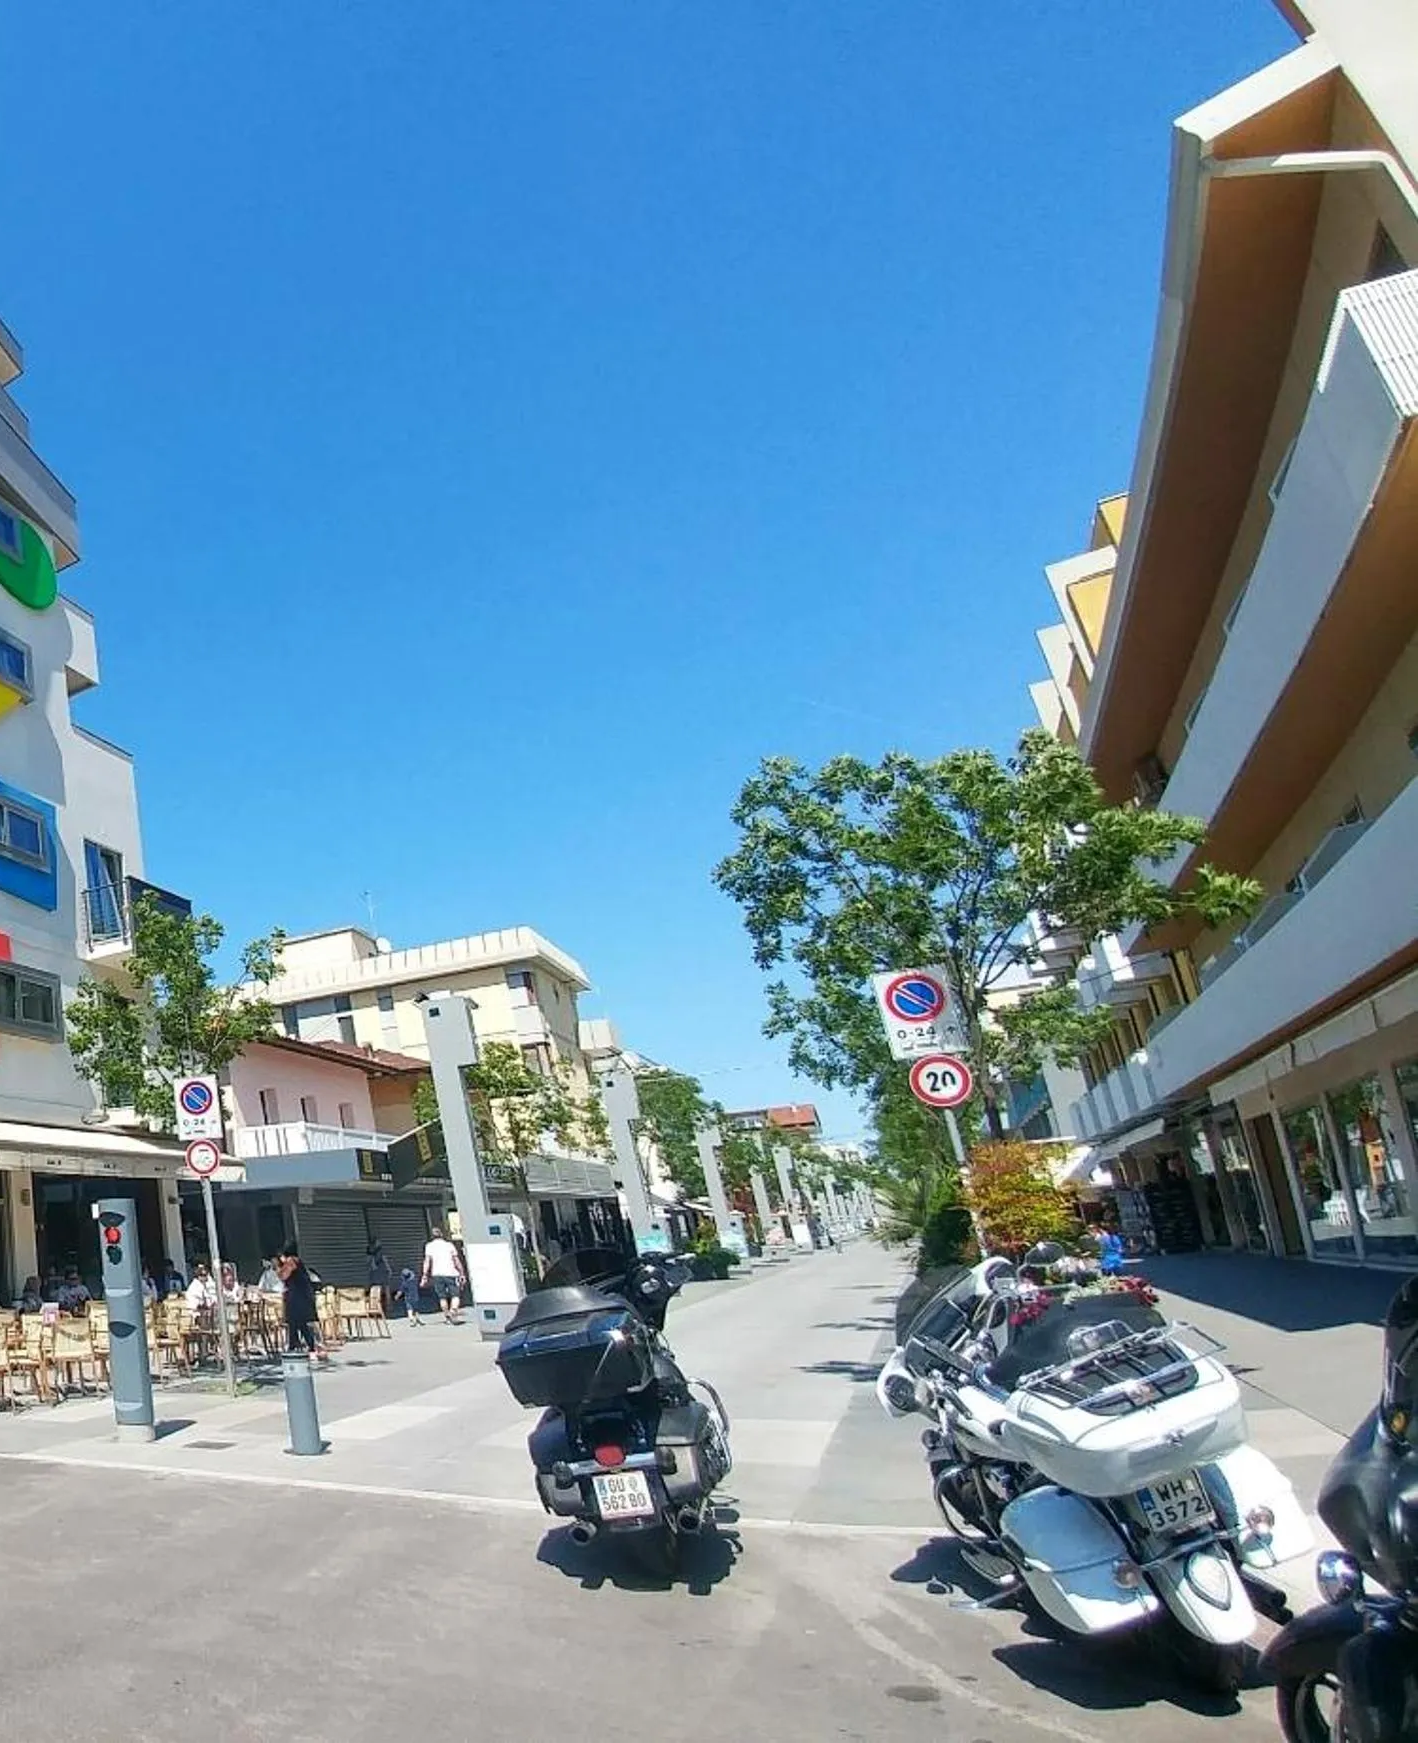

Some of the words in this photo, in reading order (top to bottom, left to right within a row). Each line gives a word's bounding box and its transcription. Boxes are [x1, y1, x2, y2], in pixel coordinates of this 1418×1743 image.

[925, 1071, 957, 1092] 20
[1155, 1479, 1186, 1502] WH
[601, 1494, 627, 1511] 562
[1150, 1496, 1206, 1527] 3572
